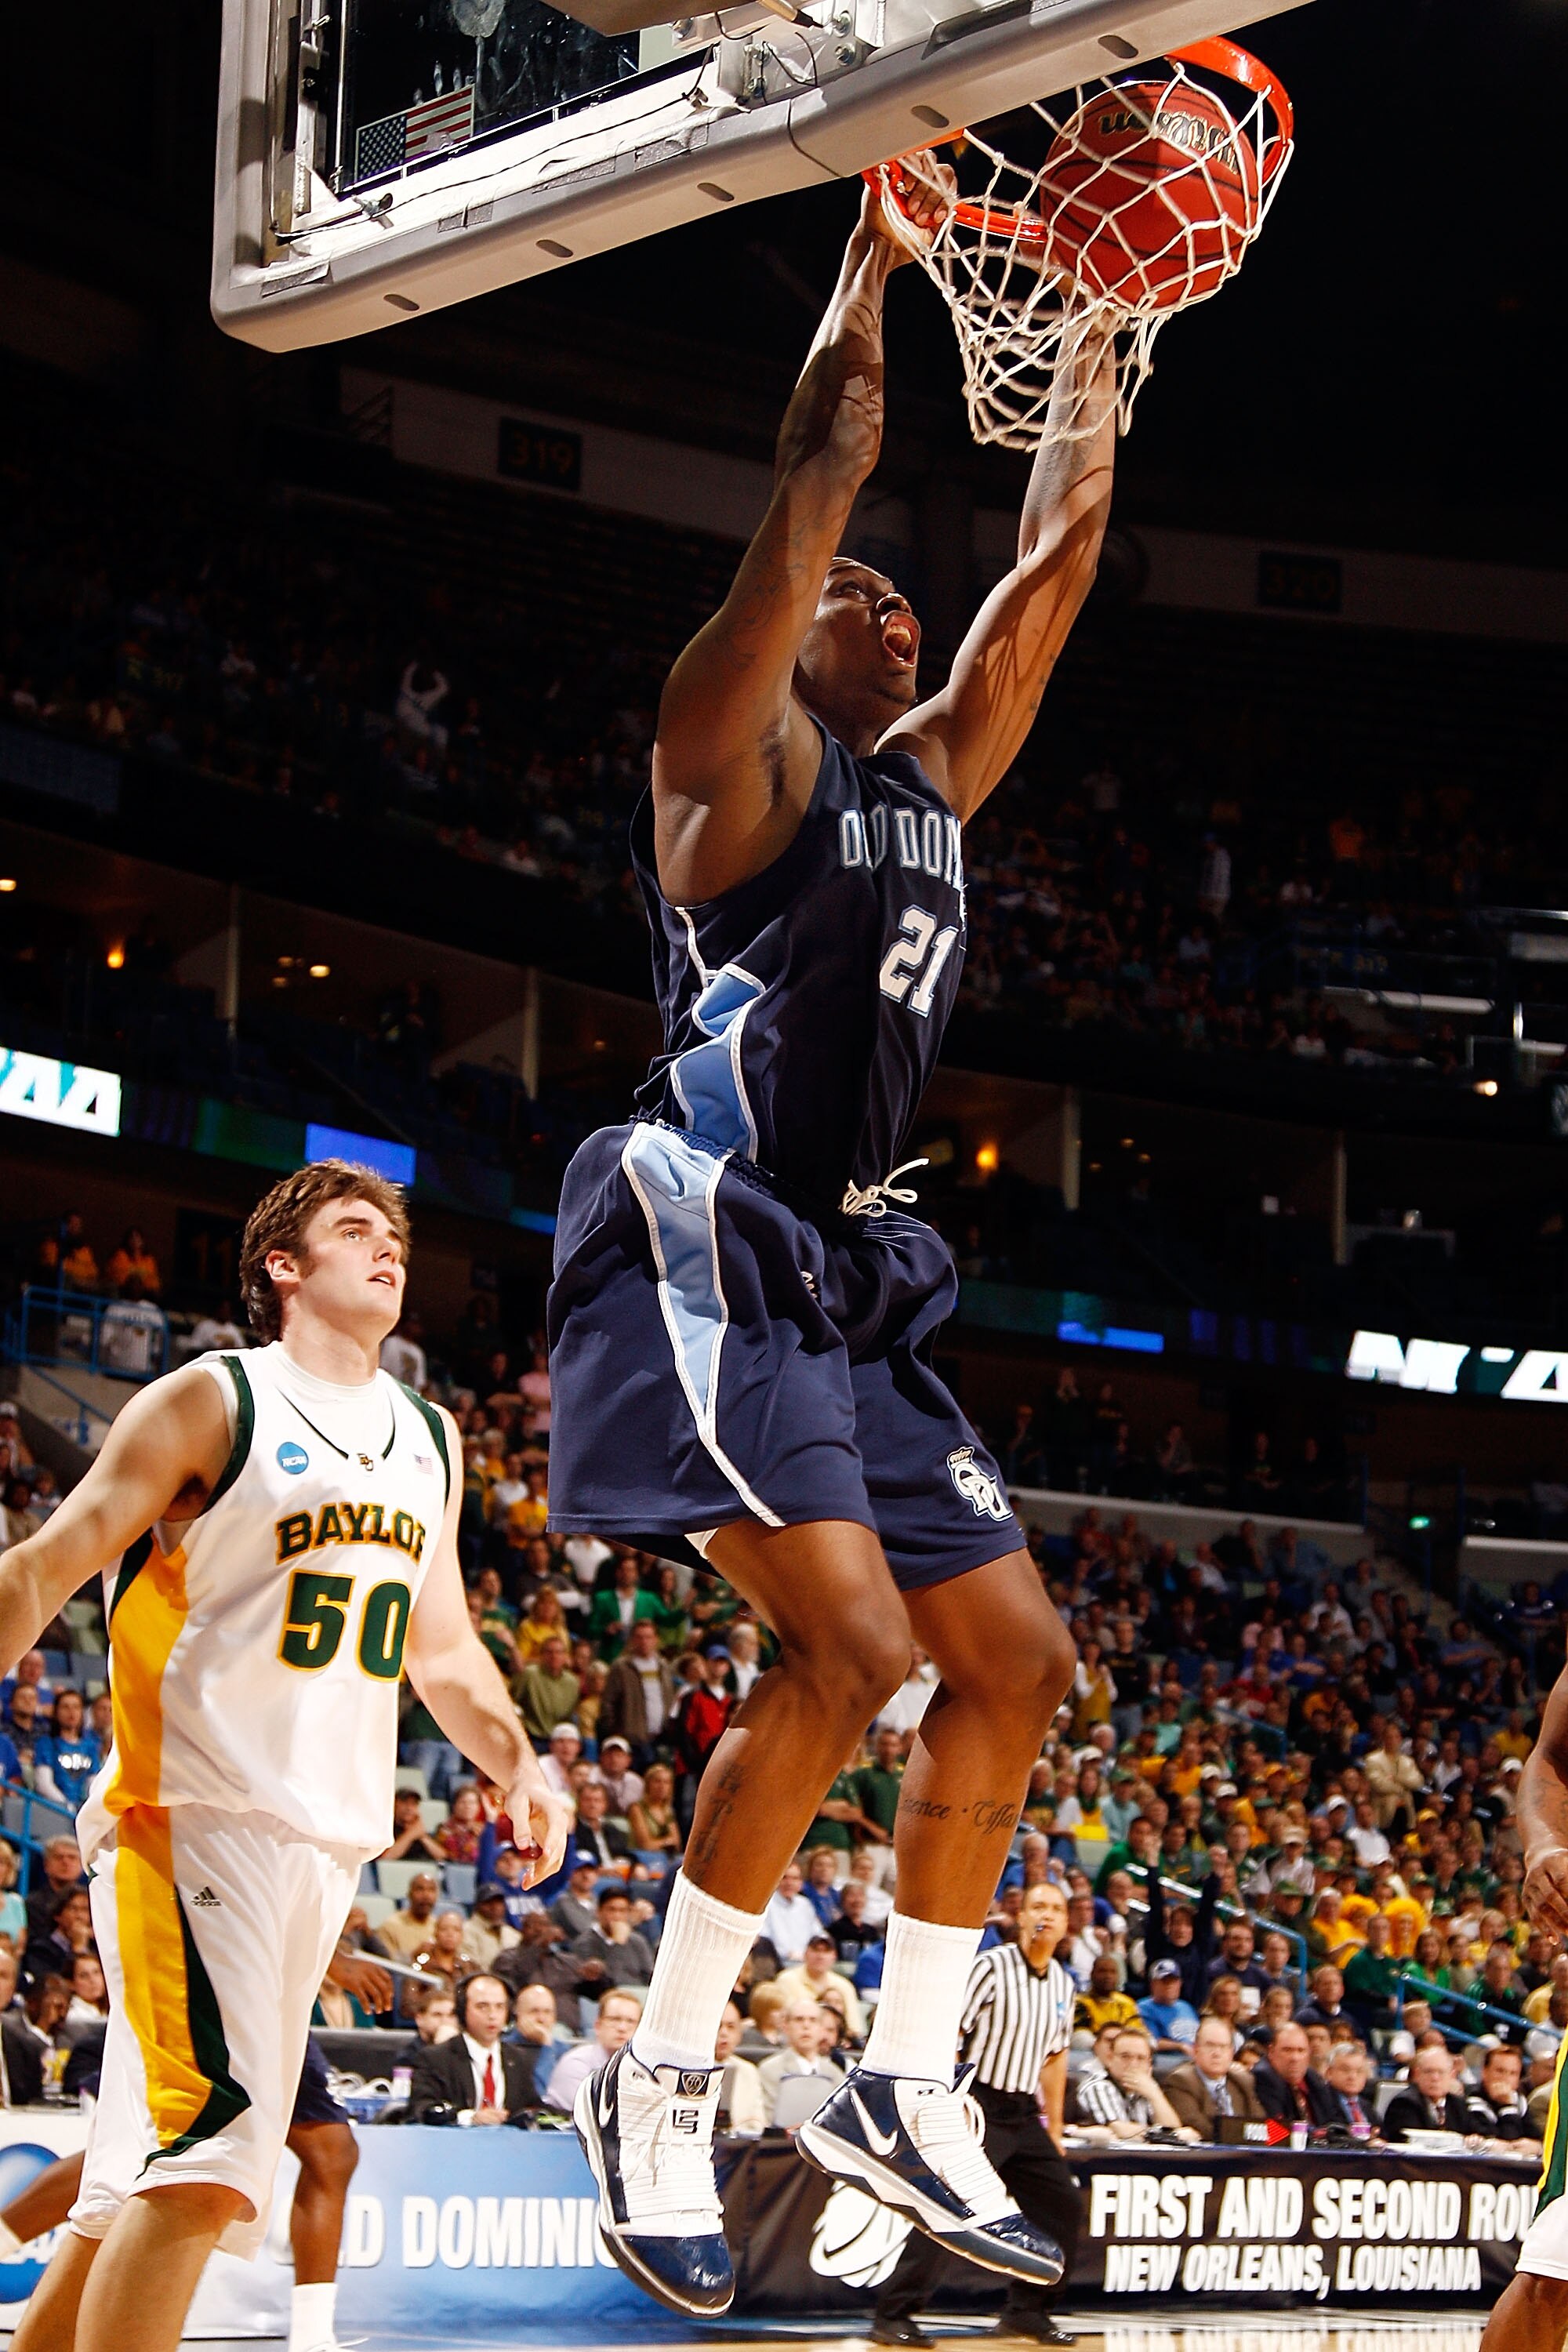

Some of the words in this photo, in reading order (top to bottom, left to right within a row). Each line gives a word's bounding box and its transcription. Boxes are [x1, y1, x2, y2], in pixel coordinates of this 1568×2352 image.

[508, 430, 575, 476] 319
[879, 905, 959, 1018] 21
[0, 1040, 122, 1137] AA
[951, 1461, 1014, 1521] ODU
[276, 1568, 412, 1682] 50
[1089, 2174, 1214, 2239] FIRST
[1216, 2176, 1304, 2239] AND
[1312, 2177, 1462, 2241] SECOND
[1103, 2244, 1182, 2292] NEW
[1181, 2244, 1330, 2301] ORLEANS,
[1335, 2244, 1482, 2292] LOUISIANA
